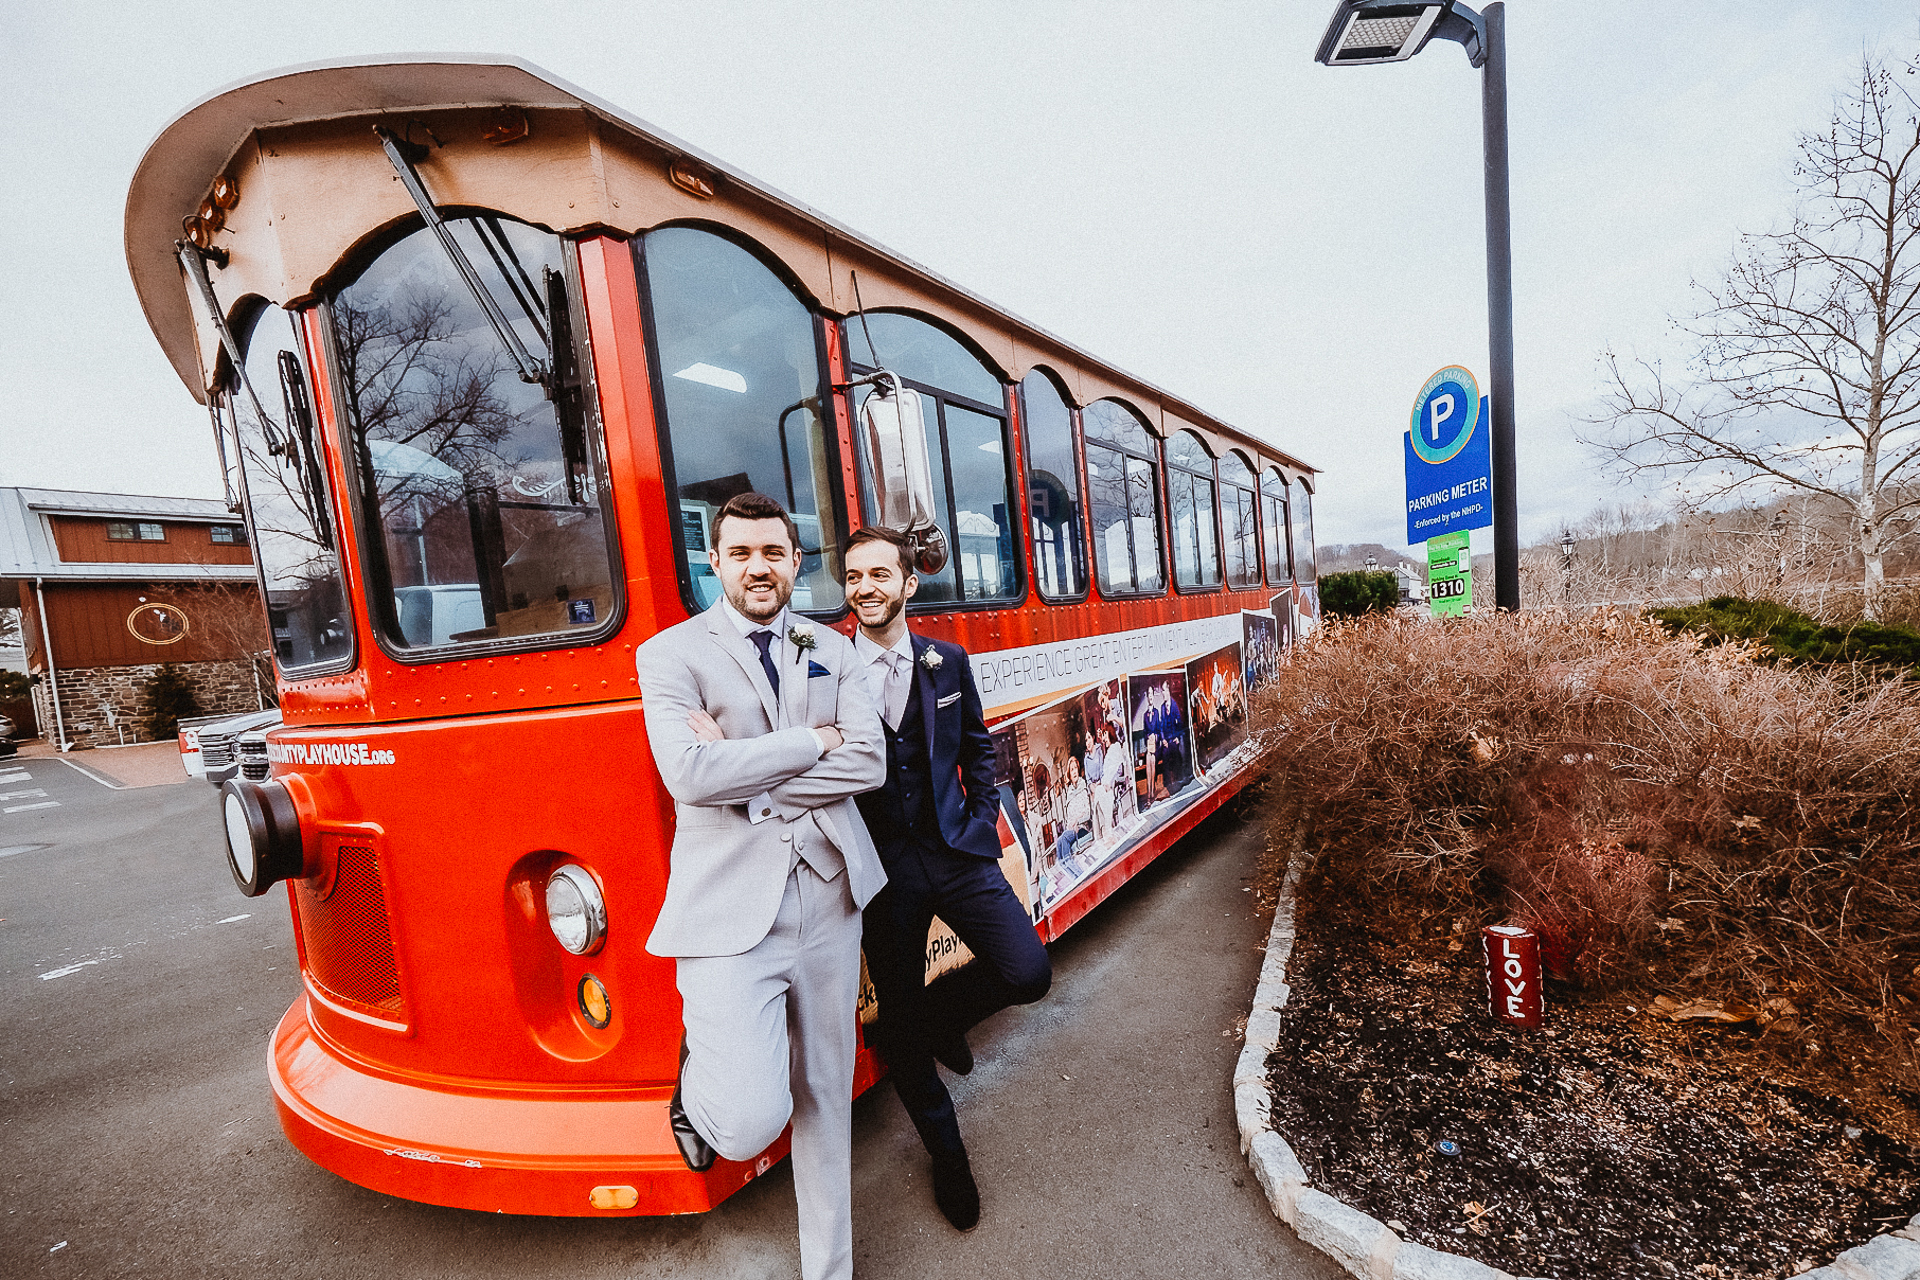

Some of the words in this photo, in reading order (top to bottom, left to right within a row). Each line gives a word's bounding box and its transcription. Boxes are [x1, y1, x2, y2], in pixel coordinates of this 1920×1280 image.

[1415, 374, 1443, 411] METERED
[1443, 370, 1472, 389] PARKING
[1430, 393, 1455, 441] P
[1408, 488, 1450, 513] PARKING
[1451, 476, 1488, 500] METER
[1441, 513, 1450, 524] by
[1450, 510, 1461, 519] the
[1432, 579, 1464, 598] 1310
[980, 648, 1072, 693] EXPERIENCE
[1074, 641, 1110, 673] GREAT
[1112, 628, 1182, 664] ENTERTAINMENT
[1503, 938, 1527, 1018] LOVE
